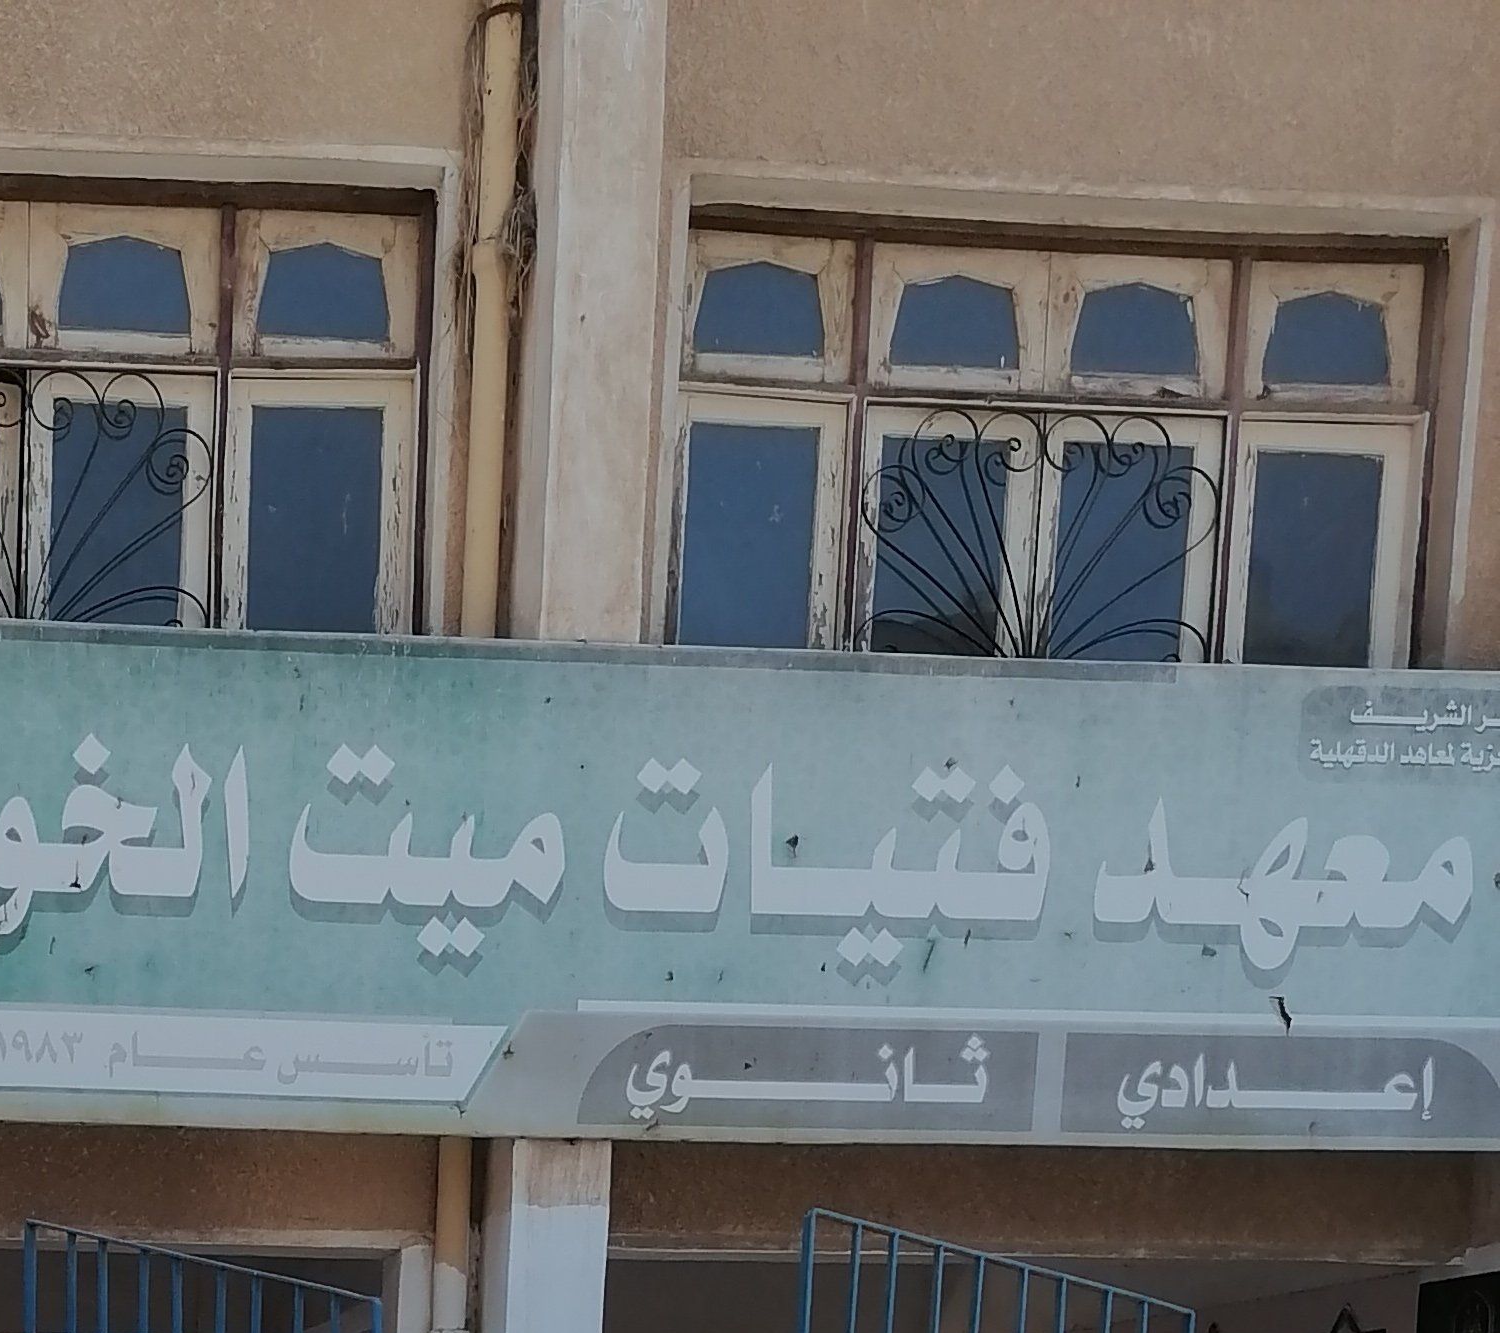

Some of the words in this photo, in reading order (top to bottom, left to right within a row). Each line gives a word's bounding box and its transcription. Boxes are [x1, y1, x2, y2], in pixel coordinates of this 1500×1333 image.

[1310, 738, 1395, 769] الدقهلية
[1350, 700, 1473, 733] الشريف
[288, 743, 566, 958] ميت
[602, 757, 1050, 966] فتيات
[1094, 798, 1474, 970] معهد
[105, 1030, 267, 1077] عام
[625, 1034, 989, 1124] ثانوي
[1116, 1055, 1434, 1131] إعدادي
